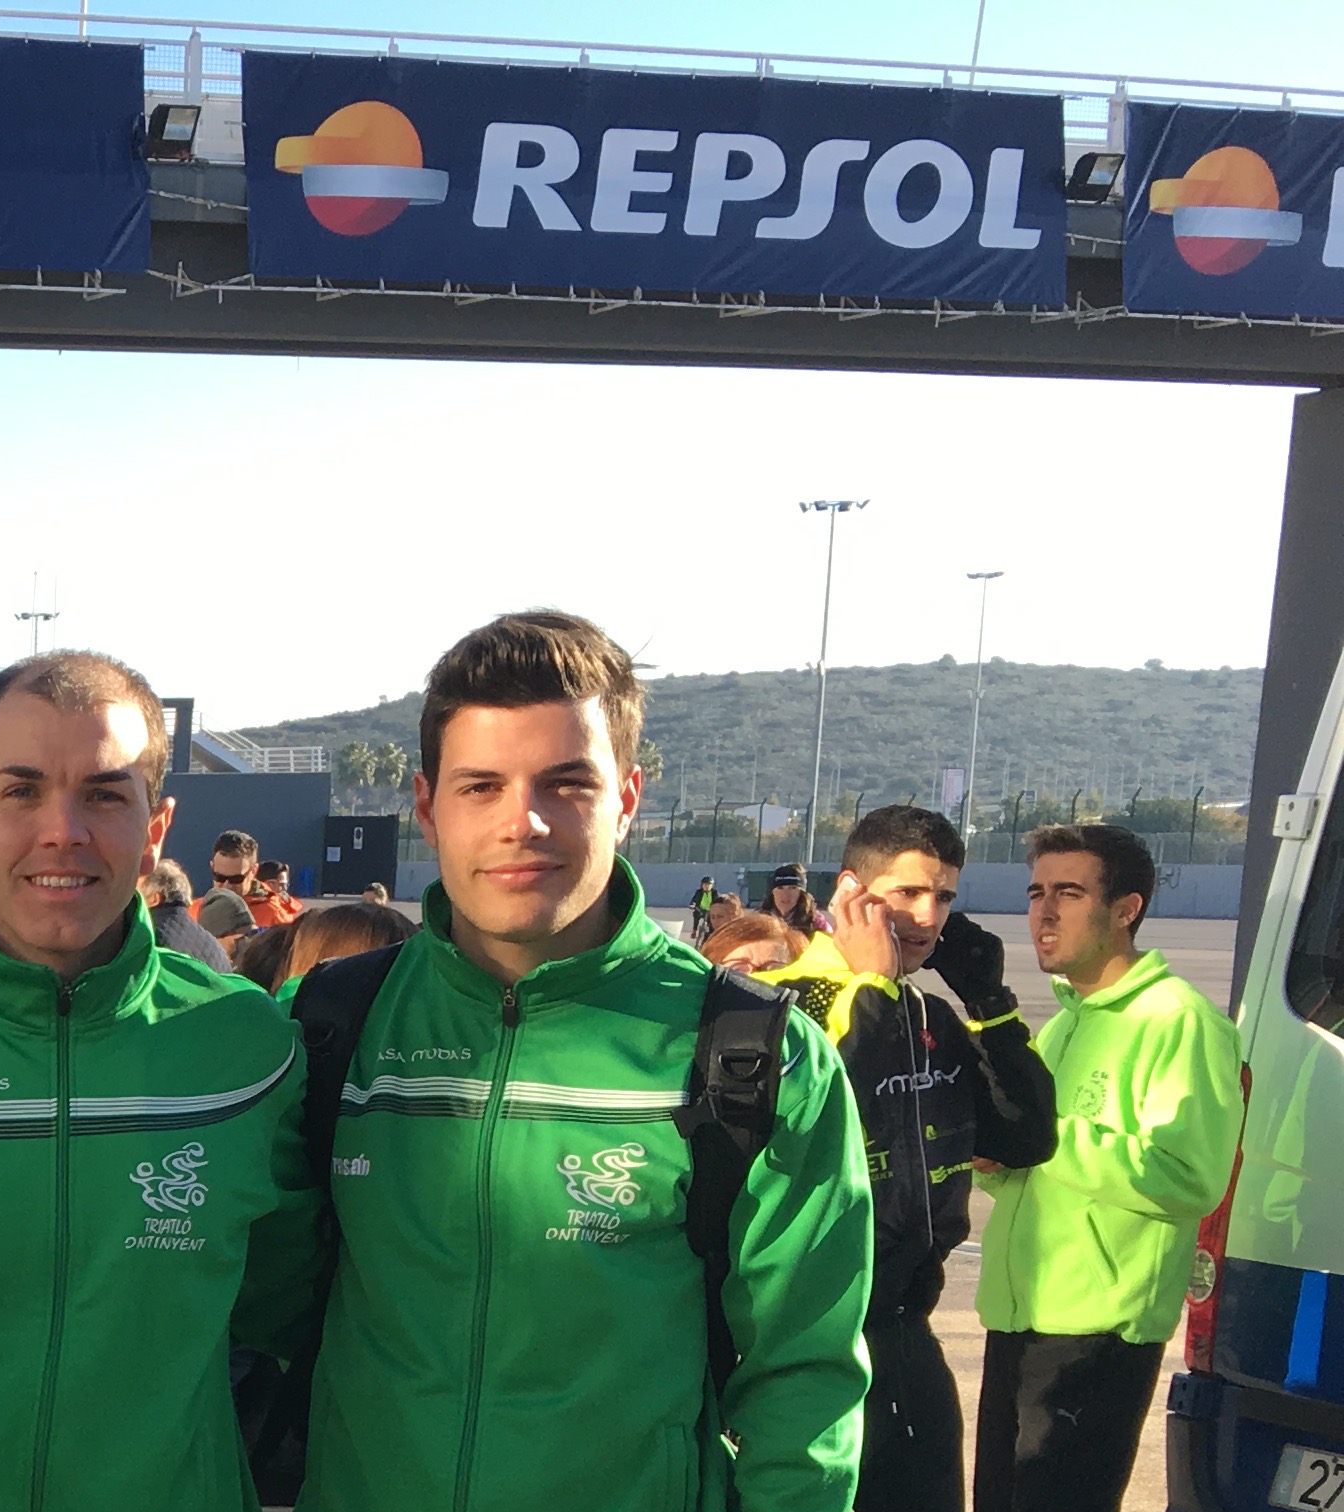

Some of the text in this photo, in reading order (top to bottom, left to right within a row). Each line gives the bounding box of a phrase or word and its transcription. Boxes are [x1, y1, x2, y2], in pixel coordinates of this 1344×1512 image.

[472, 120, 1044, 250] REPSOL
[143, 1216, 193, 1235] TRIATLÓ
[566, 1208, 621, 1230] TRIATLÓ
[124, 1235, 207, 1252] ONTINYENT
